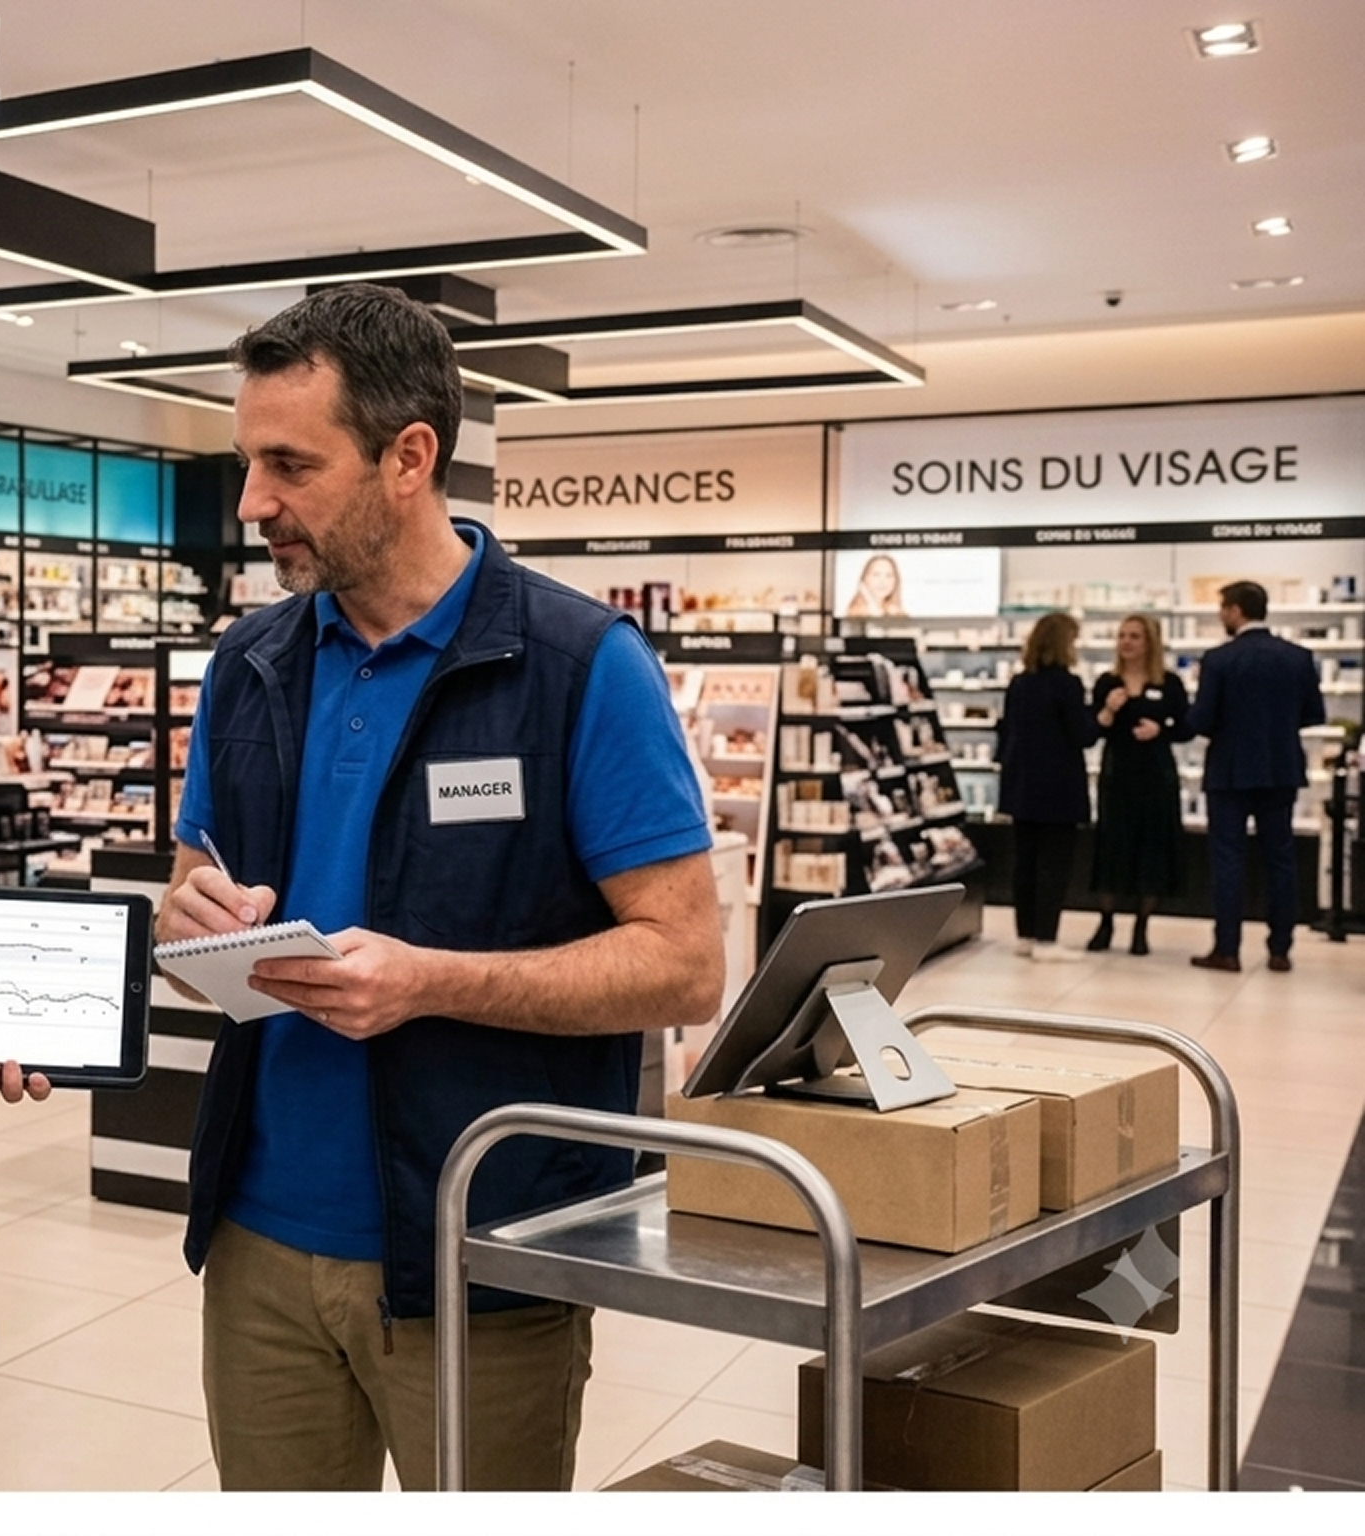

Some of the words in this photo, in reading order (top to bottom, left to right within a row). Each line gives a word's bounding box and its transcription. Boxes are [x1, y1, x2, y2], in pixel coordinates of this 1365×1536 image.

[891, 458, 1024, 496] SOINS
[1040, 453, 1103, 491] DU
[1119, 445, 1298, 487] VISAGE
[437, 781, 513, 799] MANAGER
